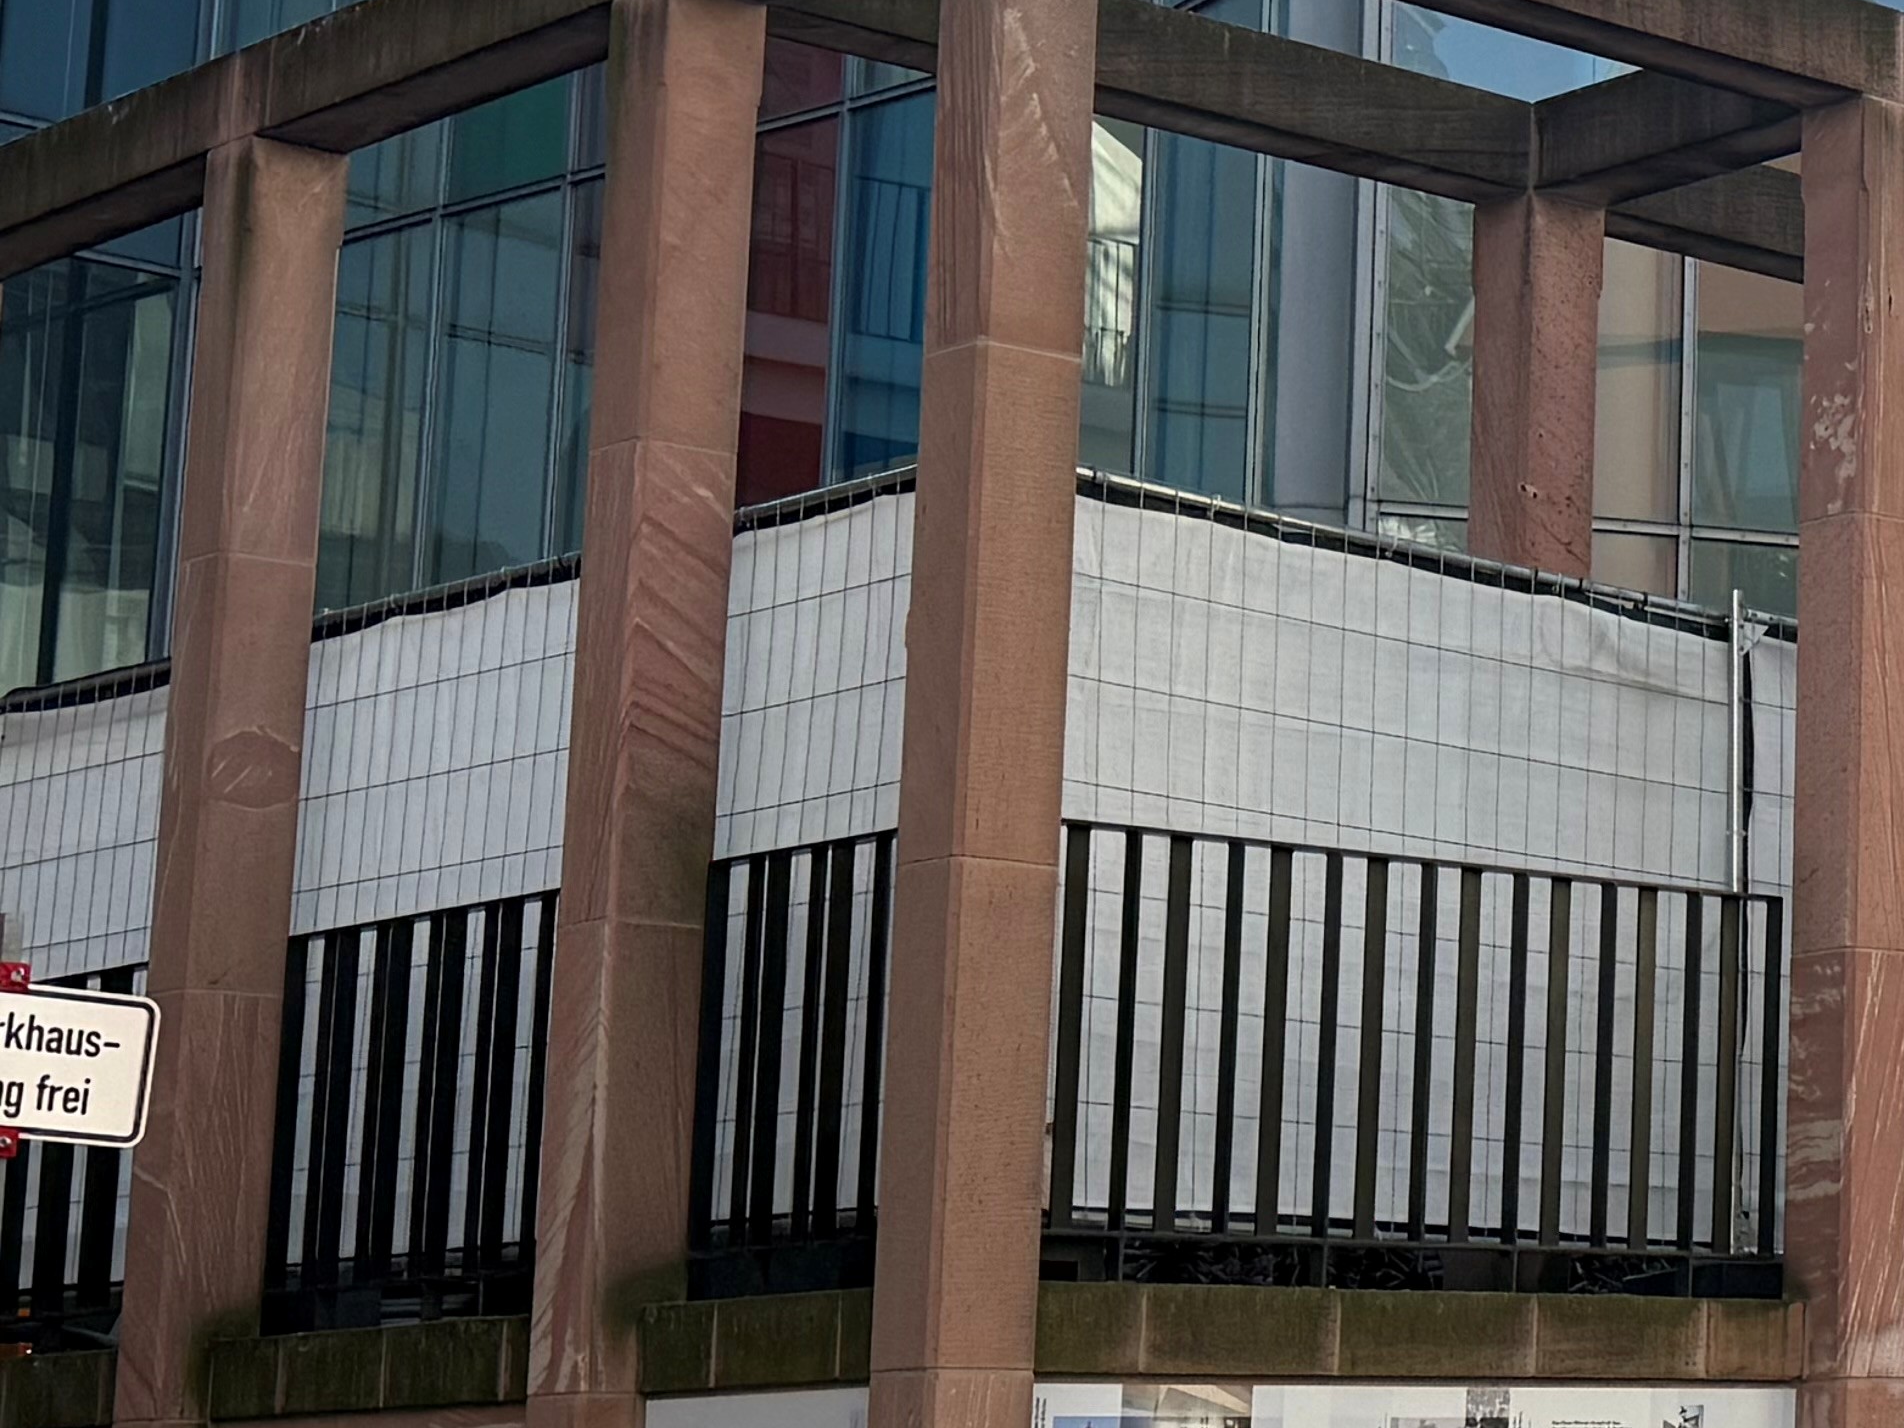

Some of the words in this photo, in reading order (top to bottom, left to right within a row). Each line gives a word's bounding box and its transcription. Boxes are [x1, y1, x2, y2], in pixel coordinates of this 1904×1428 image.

[0, 1012, 120, 1057] khaus-
[0, 1081, 24, 1119] g
[36, 1074, 91, 1115] frei
